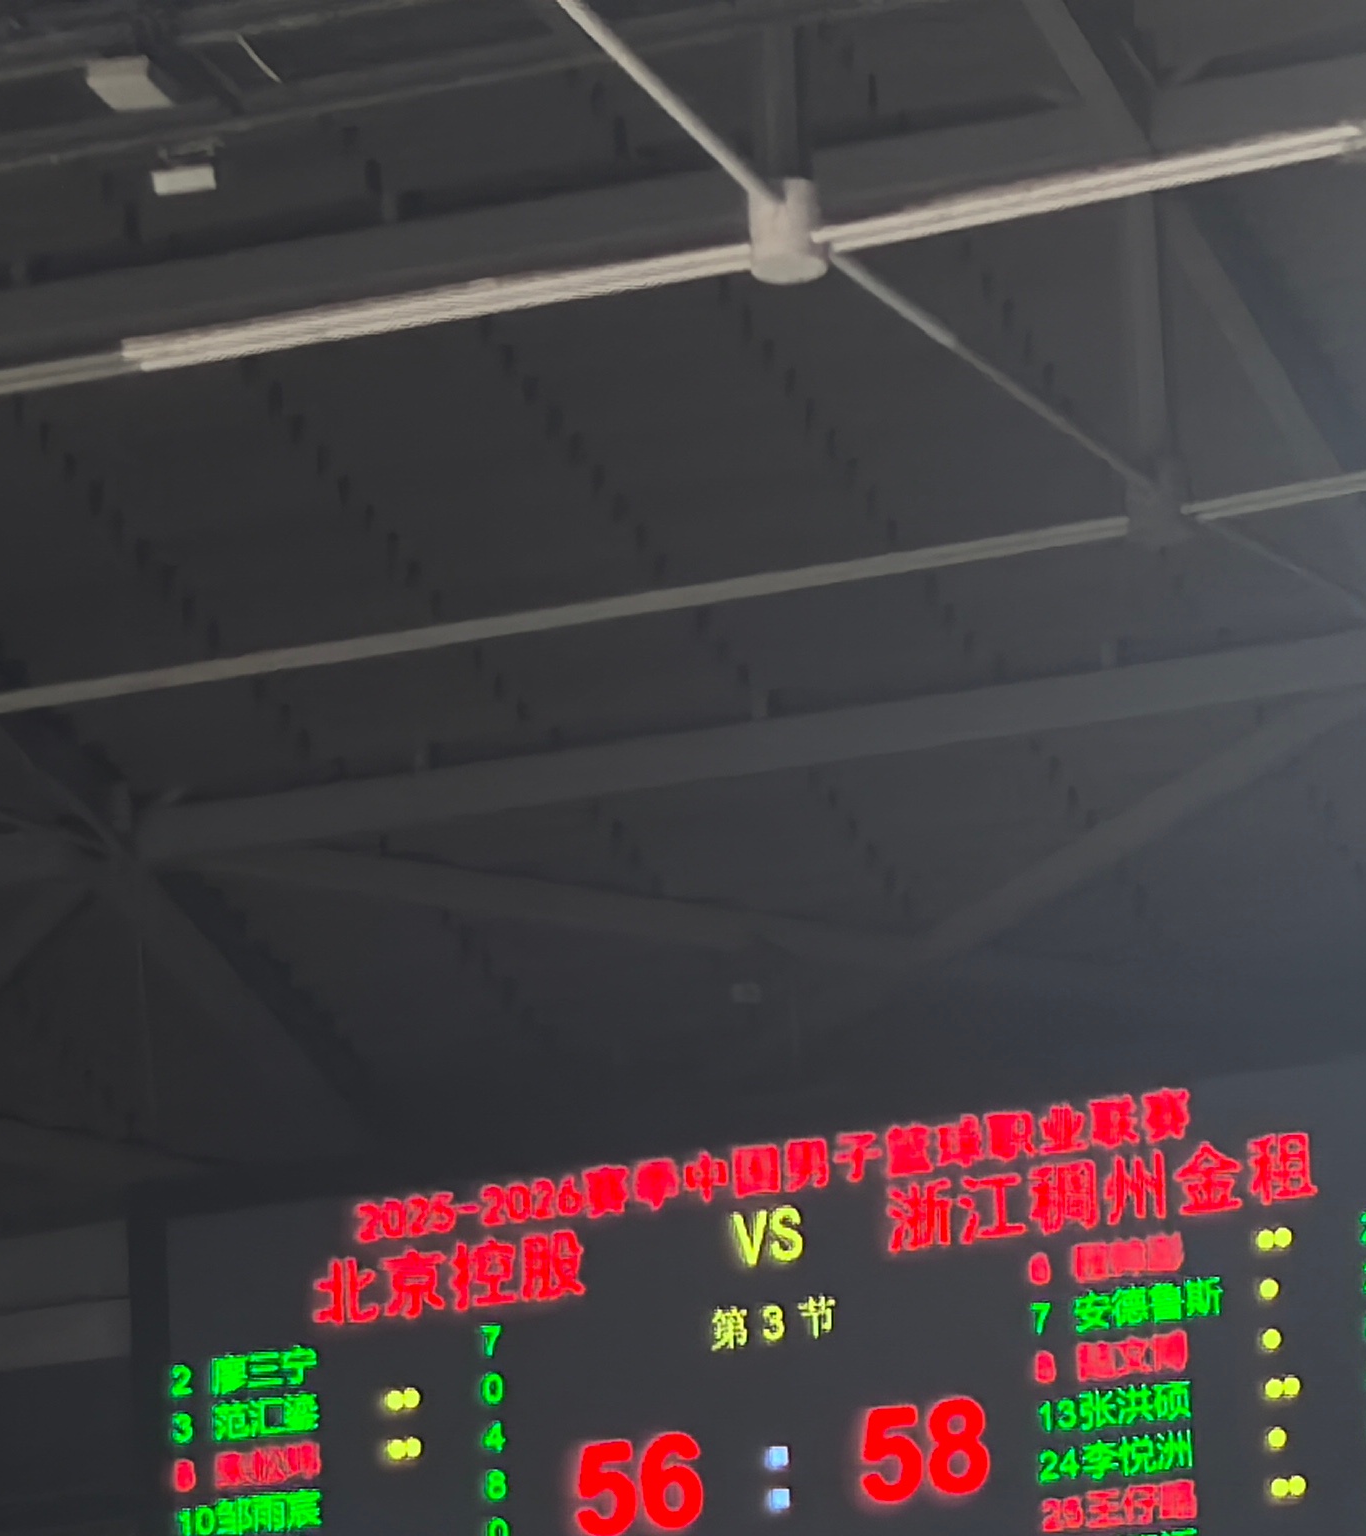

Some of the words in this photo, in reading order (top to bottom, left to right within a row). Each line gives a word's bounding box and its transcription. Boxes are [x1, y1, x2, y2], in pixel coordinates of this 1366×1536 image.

[886, 1132, 1319, 1255] 浙江稠州金租
[731, 1205, 805, 1268] VS
[312, 1229, 587, 1327] 北京控股
[1030, 1302, 1053, 1334] 7
[1072, 1276, 1224, 1335] 安德鲁斯
[169, 1364, 194, 1398] 2
[481, 1323, 505, 1356] 7
[172, 1412, 195, 1445] 3
[481, 1373, 505, 1406] 0
[482, 1422, 507, 1453] 4
[484, 1470, 509, 1503] 8
[859, 1396, 991, 1506] 58
